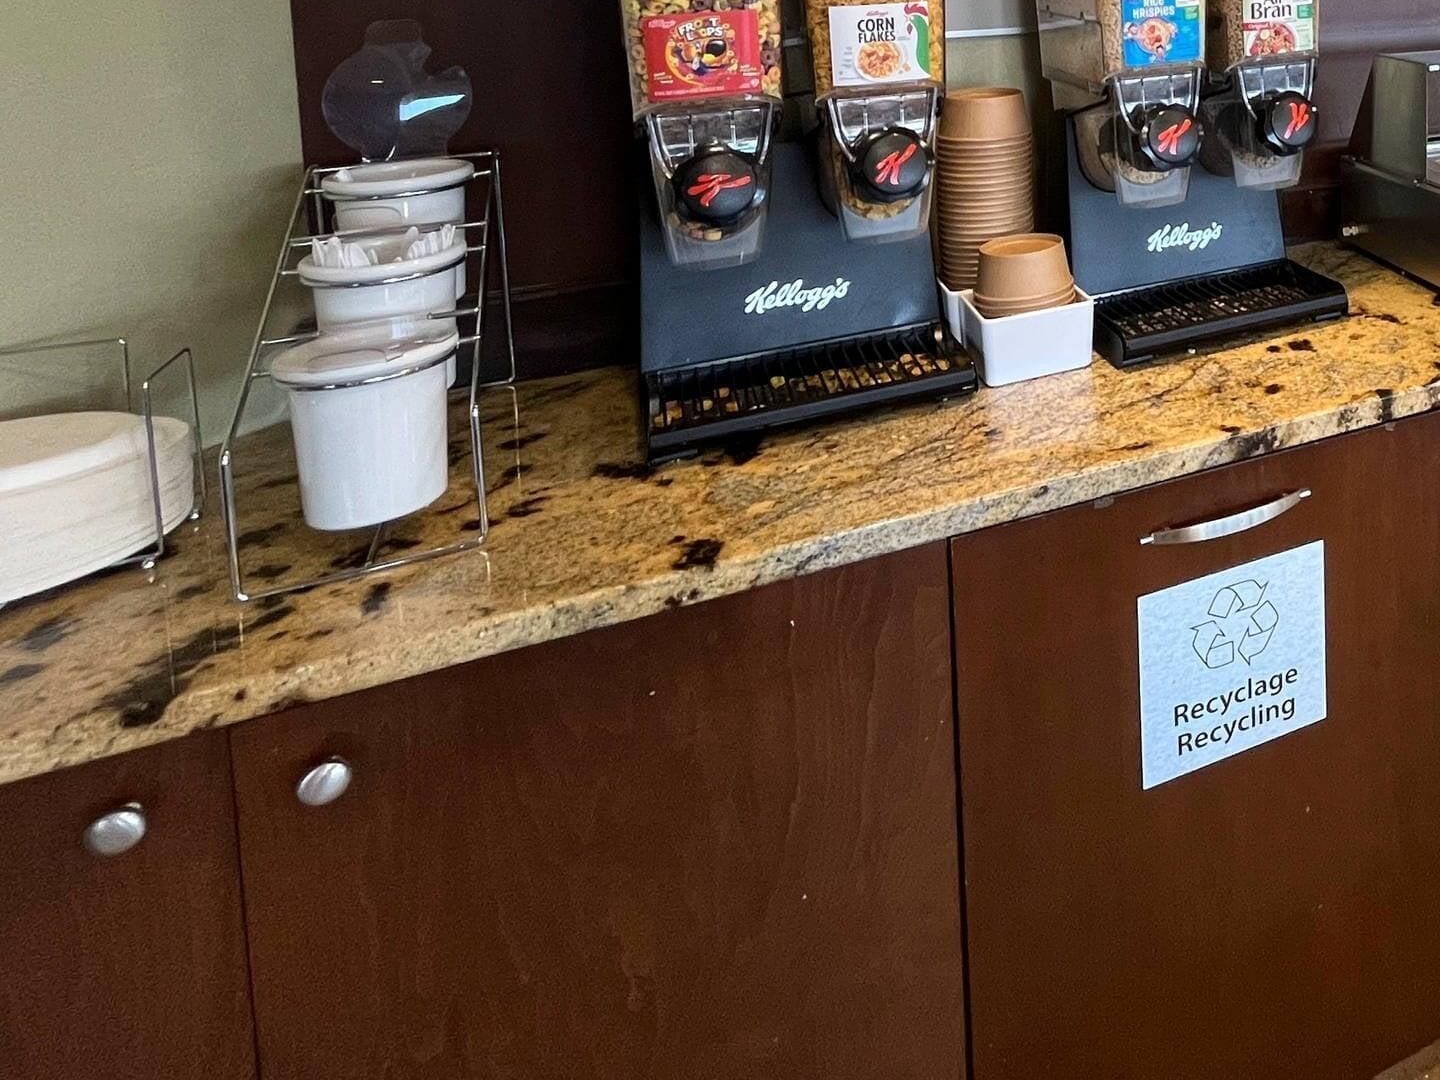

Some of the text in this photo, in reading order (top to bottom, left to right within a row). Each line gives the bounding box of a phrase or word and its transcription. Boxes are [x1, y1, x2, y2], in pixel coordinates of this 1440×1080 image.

[857, 17, 895, 33] CORN
[1251, 3, 1292, 20] Bran
[858, 30, 896, 44] FLAKES
[1158, 119, 1191, 155] K
[875, 143, 917, 185] K
[1147, 221, 1222, 252] Kellogg's
[744, 277, 850, 314] Kellogg's
[1174, 668, 1298, 727] Recyclage
[1178, 697, 1295, 756] Recycling
